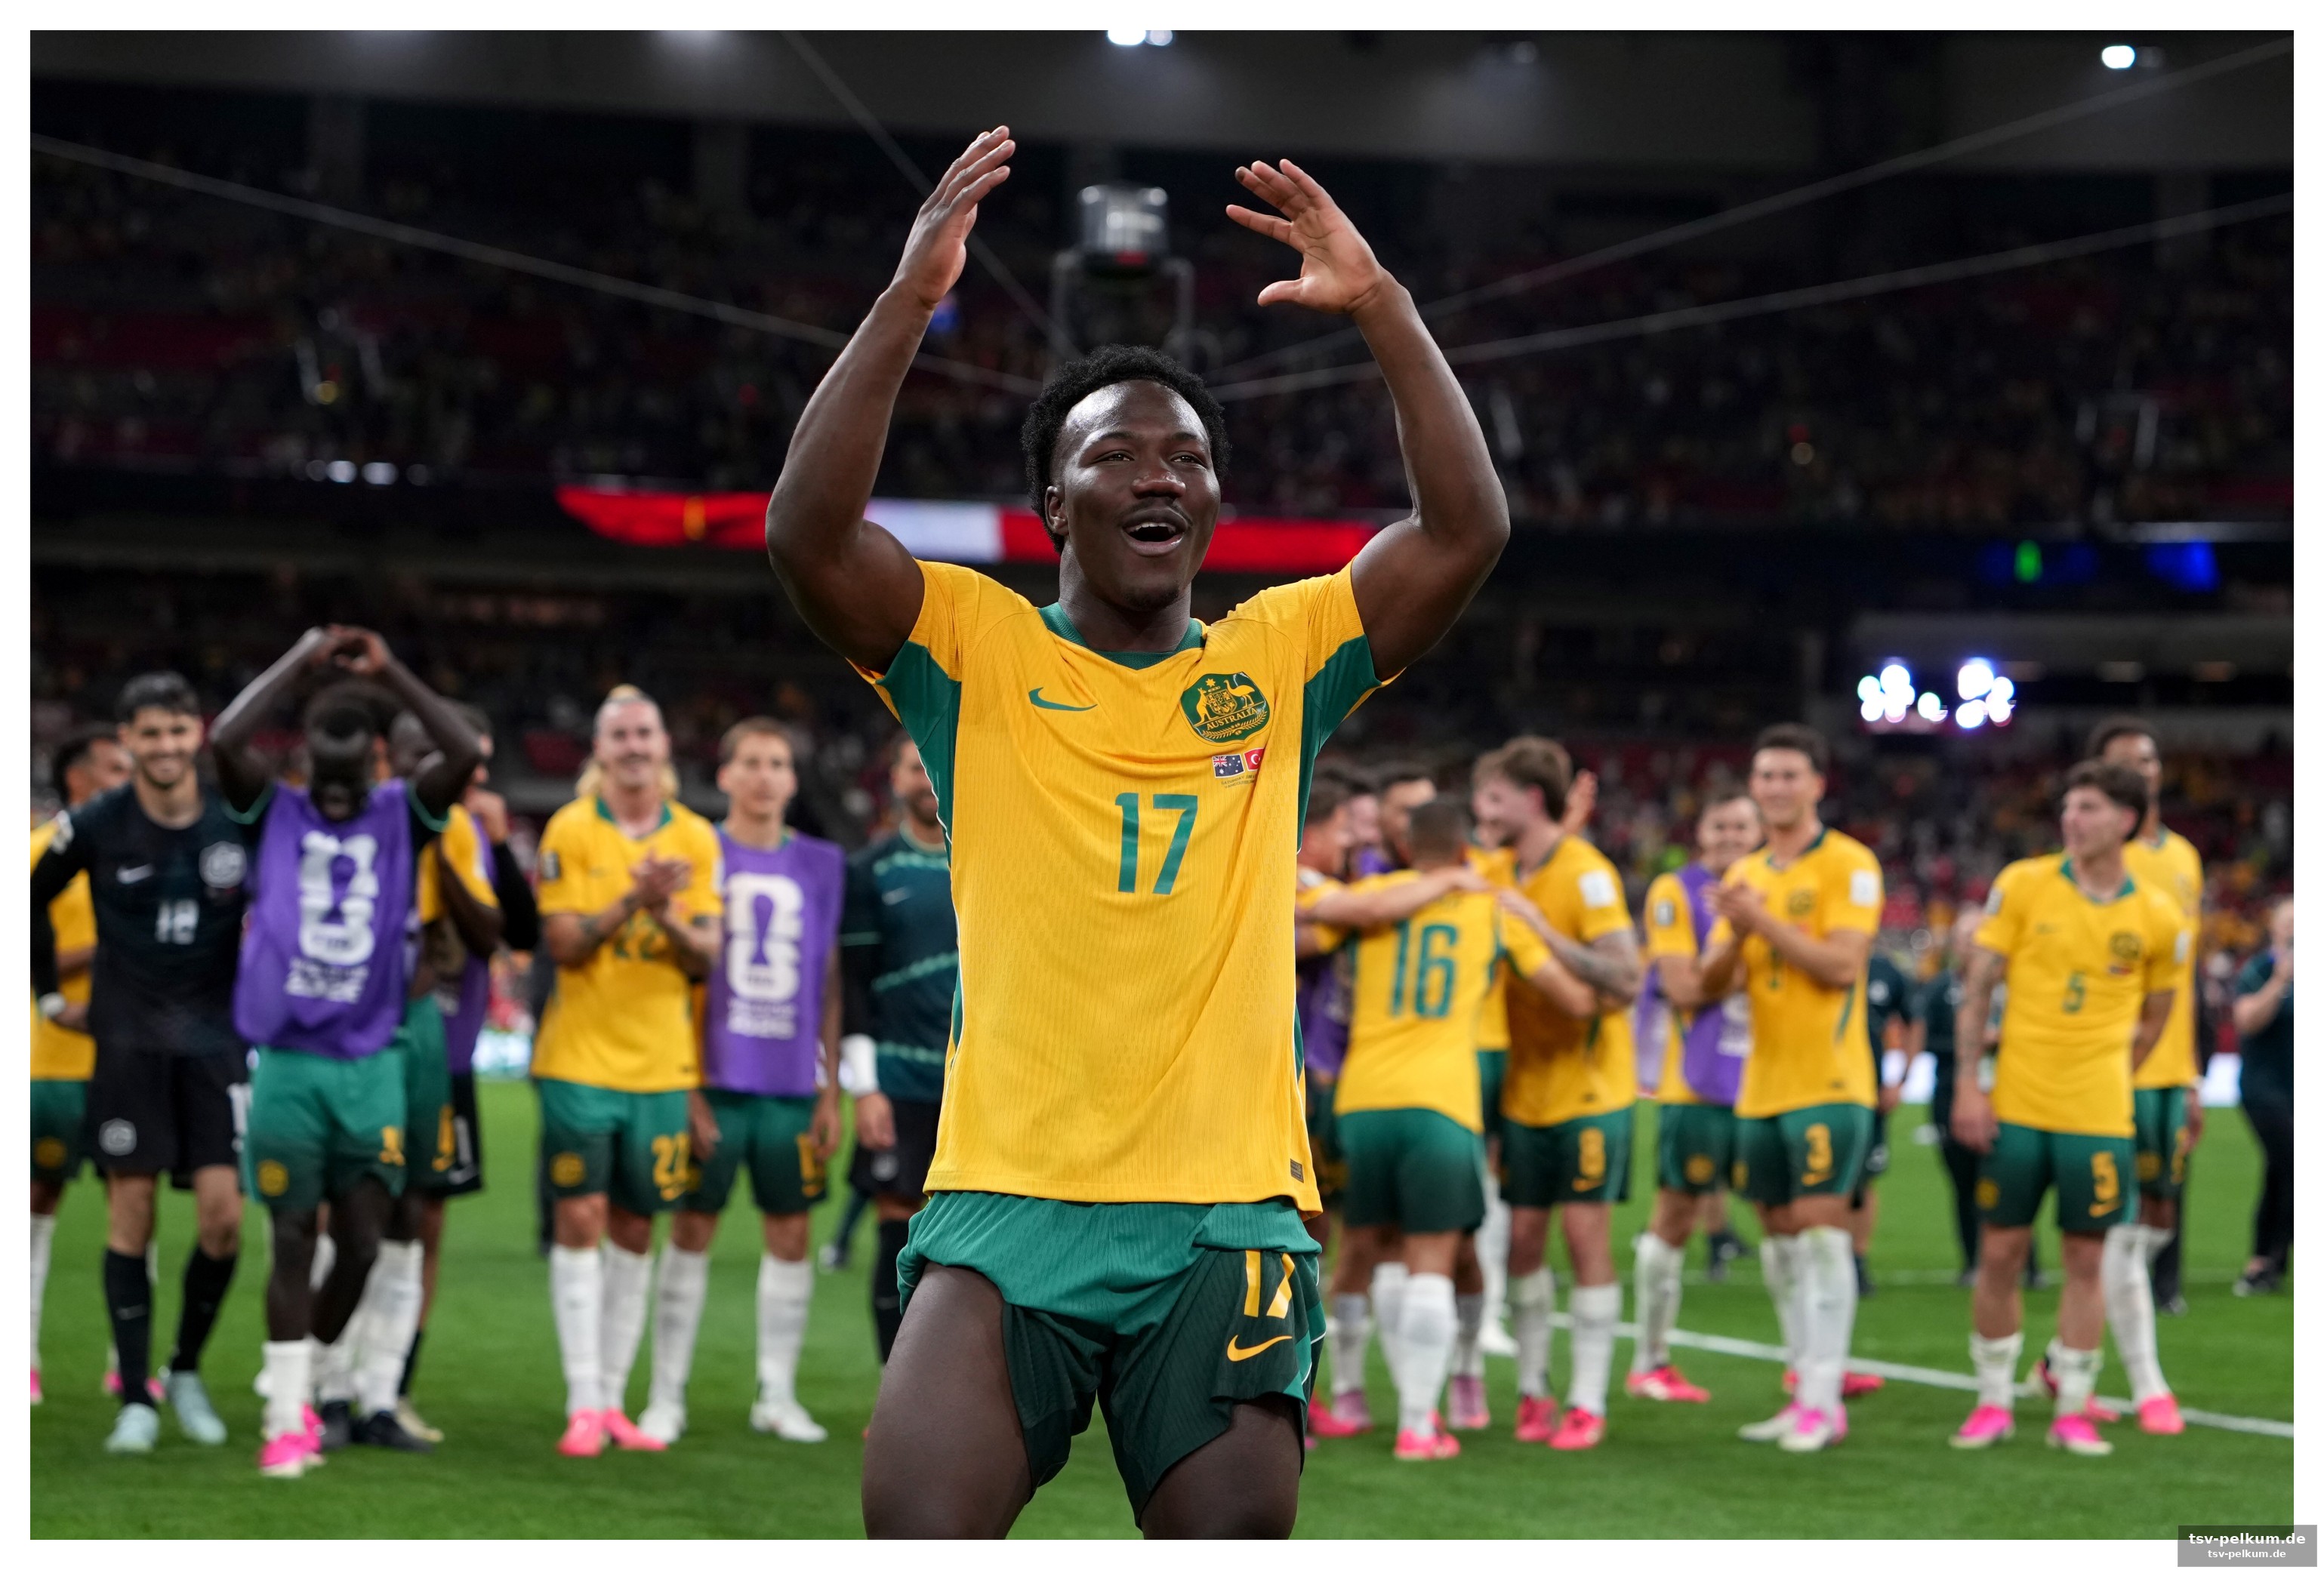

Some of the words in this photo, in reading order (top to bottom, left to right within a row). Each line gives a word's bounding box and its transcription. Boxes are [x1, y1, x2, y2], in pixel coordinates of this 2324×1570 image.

[1207, 707, 1258, 731] AUSTRALIA
[1114, 792, 1198, 894] 17
[1391, 919, 1458, 1018] 16
[1579, 1127, 1606, 1178] 8
[1805, 1123, 1833, 1171] 3
[2091, 1151, 2119, 1200] 5
[1244, 1250, 1295, 1319] 17
